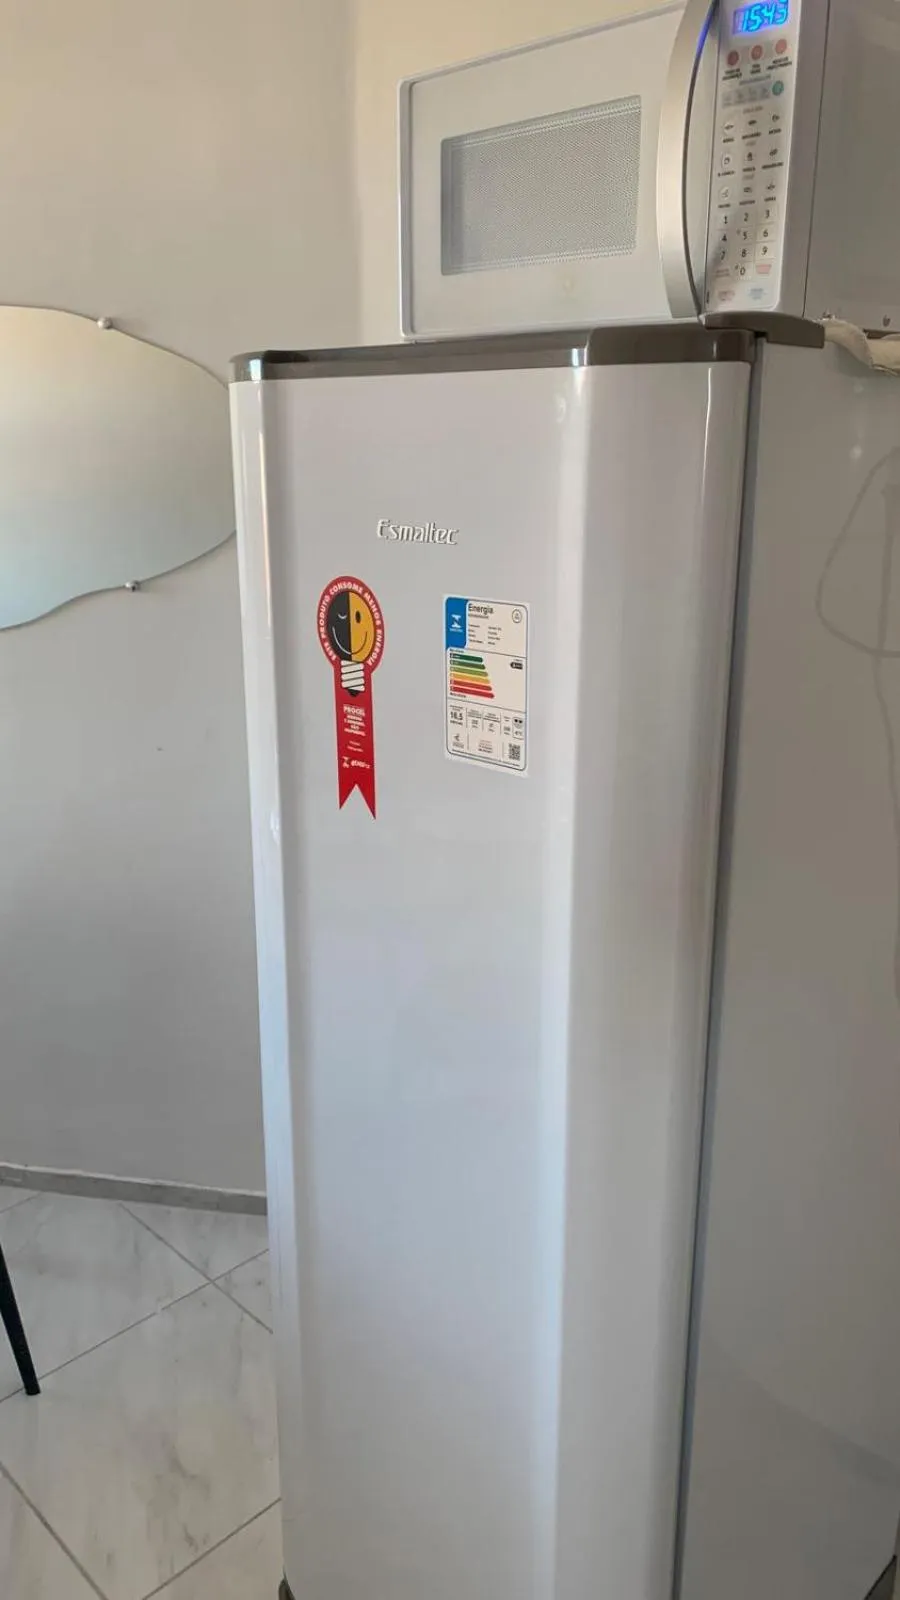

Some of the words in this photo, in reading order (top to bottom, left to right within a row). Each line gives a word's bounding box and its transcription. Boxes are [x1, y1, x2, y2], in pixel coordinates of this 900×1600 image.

[724, 215, 728, 224] 1
[743, 212, 749, 222] 2
[765, 209, 770, 219] 3
[722, 234, 727, 242] 4
[743, 231, 748, 240] 5
[763, 229, 768, 237] 6
[721, 250, 726, 260] 7
[741, 249, 747, 257] 8
[762, 246, 768, 255] 9
[740, 266, 746, 275] 0
[376, 519, 460, 545] Esmaltec
[329, 581, 364, 596] CONSOME
[364, 592, 381, 626] MENOS
[468, 603, 494, 616] Energia
[319, 594, 331, 640] PRODUTO
[323, 641, 337, 661] ESTE
[366, 629, 383, 667] ENERGIA
